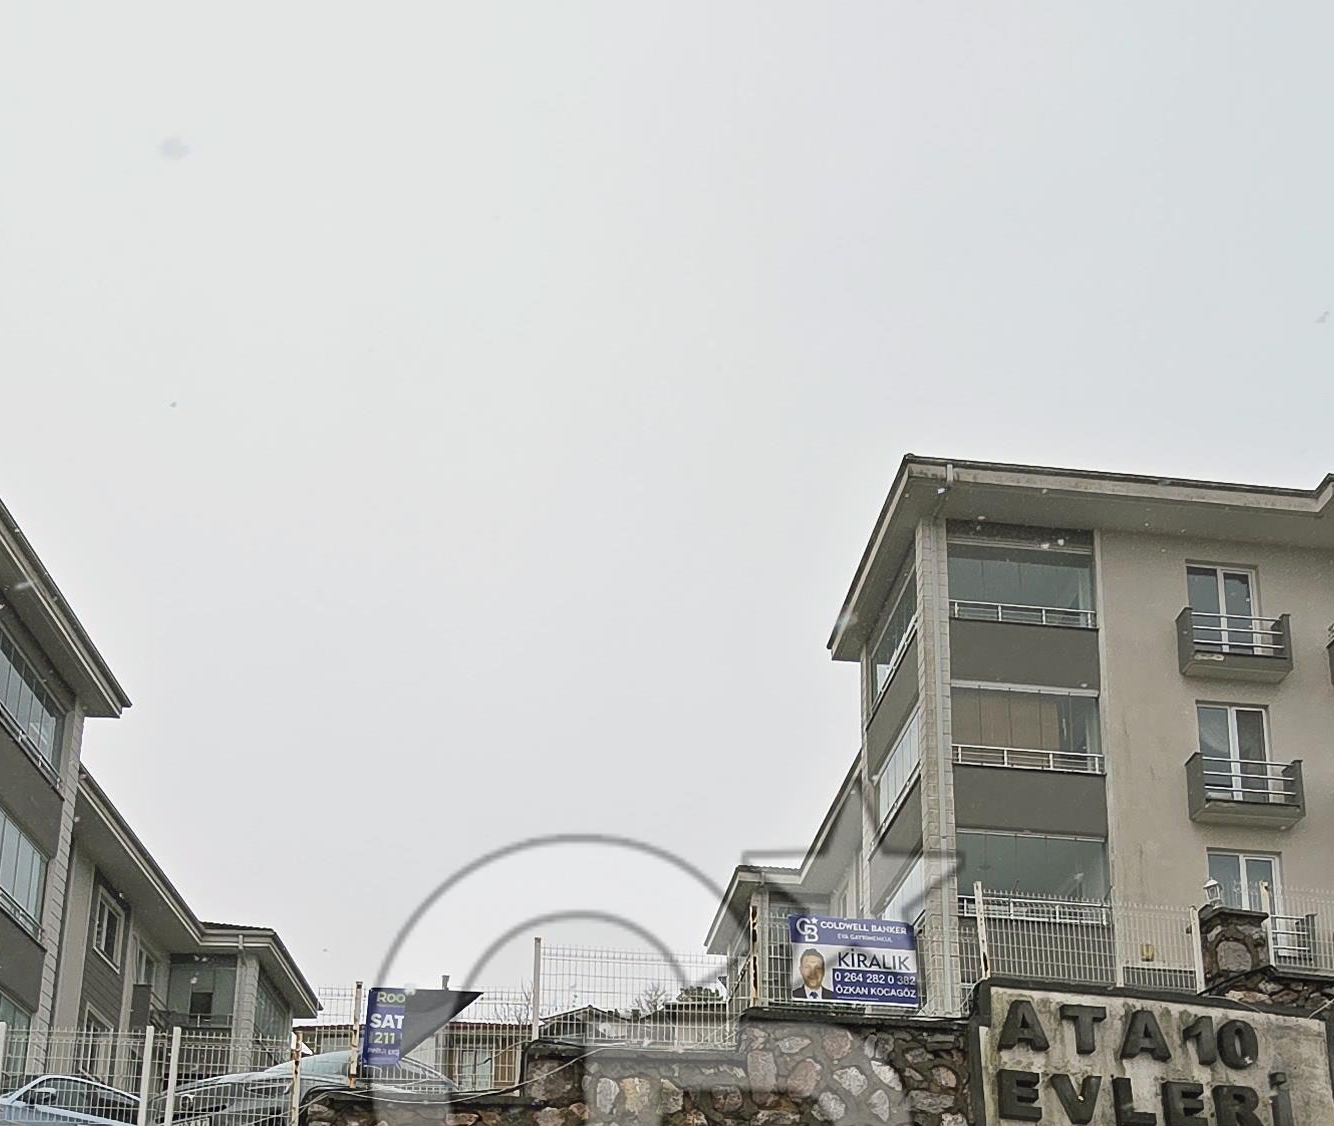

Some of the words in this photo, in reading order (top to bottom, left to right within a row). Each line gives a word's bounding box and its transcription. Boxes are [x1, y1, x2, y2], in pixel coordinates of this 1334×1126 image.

[820, 921, 869, 932] COLDWELL
[871, 925, 907, 935] BANKER
[838, 948, 911, 971] KİRALIK
[834, 972, 842, 982] 0
[844, 973, 863, 983] 264
[866, 974, 885, 984] 282
[887, 975, 894, 984] 0
[897, 976, 916, 985] 382
[835, 985, 868, 995] ÖZKAN
[870, 987, 917, 998] KOCAGÖZ
